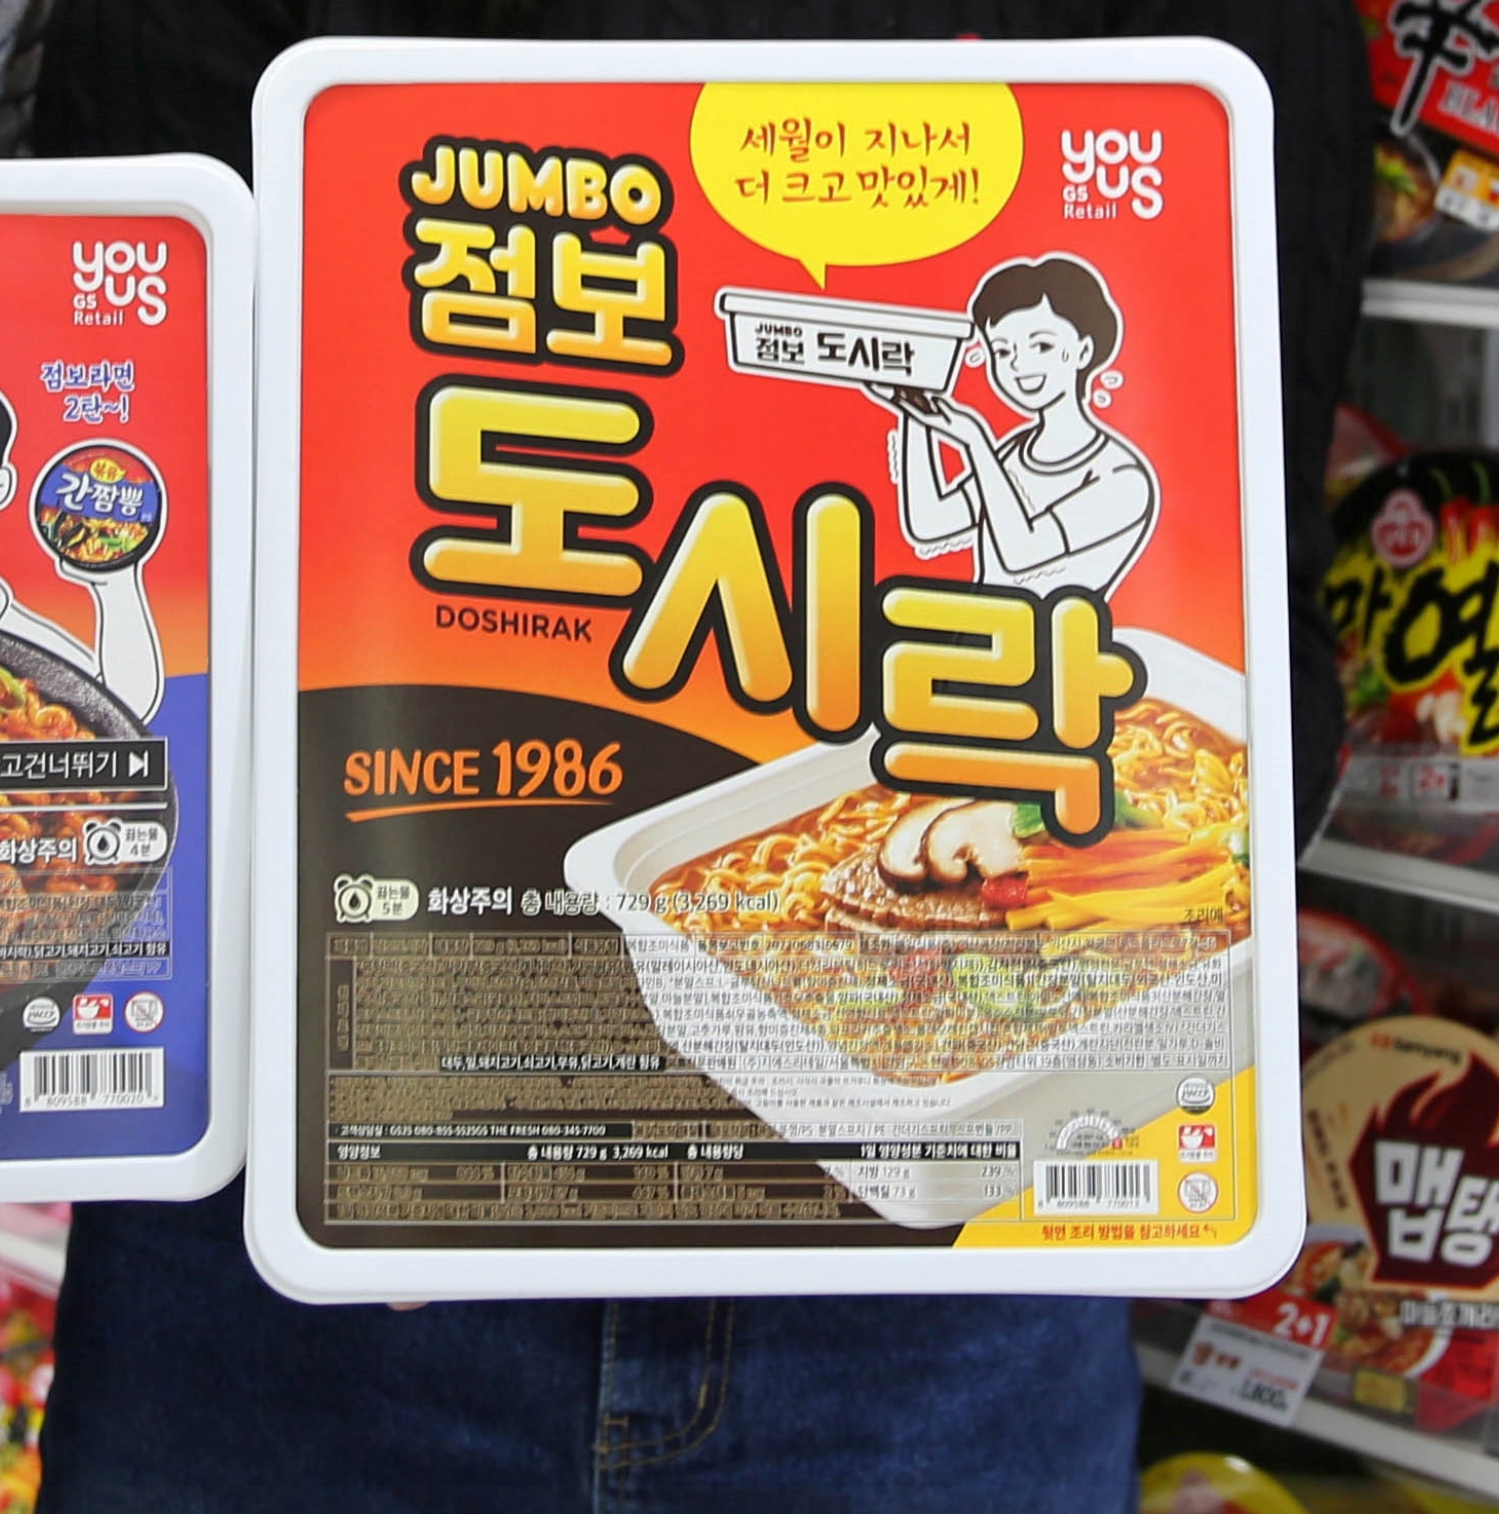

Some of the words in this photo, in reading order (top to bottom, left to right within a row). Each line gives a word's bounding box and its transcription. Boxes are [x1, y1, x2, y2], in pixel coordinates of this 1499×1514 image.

[740, 117, 847, 163] 세월이
[863, 121, 972, 158] 지나서
[410, 143, 664, 226] JUMBO
[735, 167, 770, 204] 더
[782, 170, 853, 205] 크고
[858, 166, 981, 211] 맛있게!
[1062, 186, 1088, 202] GS
[1063, 203, 1118, 220] Retail
[73, 294, 98, 309] GS
[413, 216, 673, 367] 점보
[74, 310, 124, 326] Retail
[754, 336, 805, 366] 점보
[816, 331, 916, 376] 도시락
[41, 360, 136, 392] 점보라면
[418, 380, 1142, 840] 도시락
[435, 604, 593, 643] DOSHIRAK
[343, 749, 481, 797] SINCE
[491, 738, 624, 798] 1986
[427, 886, 513, 915] 화상주의
[544, 888, 600, 916] 내용량
[616, 891, 652, 912] 729
[672, 891, 730, 914] (3,269
[735, 891, 780, 913] kcal)
[576, 1145, 597, 1159] 729
[645, 1145, 668, 1159] kcal
[1071, 1225, 1096, 1241] 조리
[1139, 1225, 1201, 1241] 참고하세요
